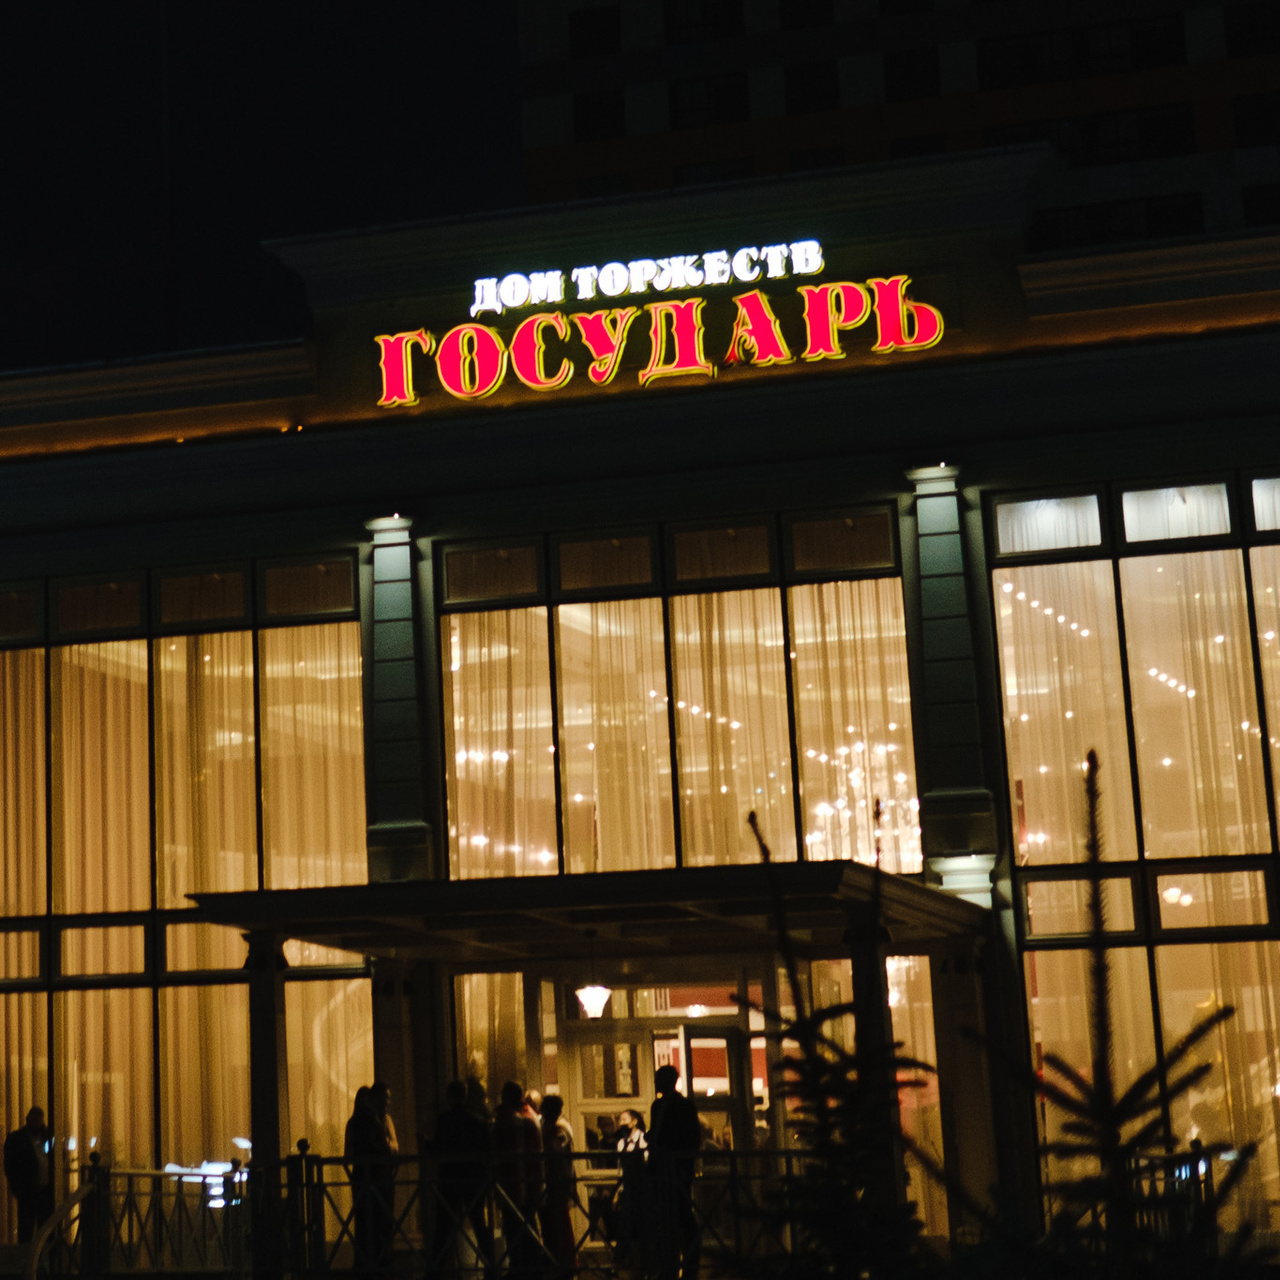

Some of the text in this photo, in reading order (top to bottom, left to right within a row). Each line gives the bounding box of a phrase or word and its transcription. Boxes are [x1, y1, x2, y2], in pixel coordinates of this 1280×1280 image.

[470, 239, 824, 317] ДОМ ТОРЖЕСТВ
[375, 274, 944, 407] ГОСУДАРЬ
